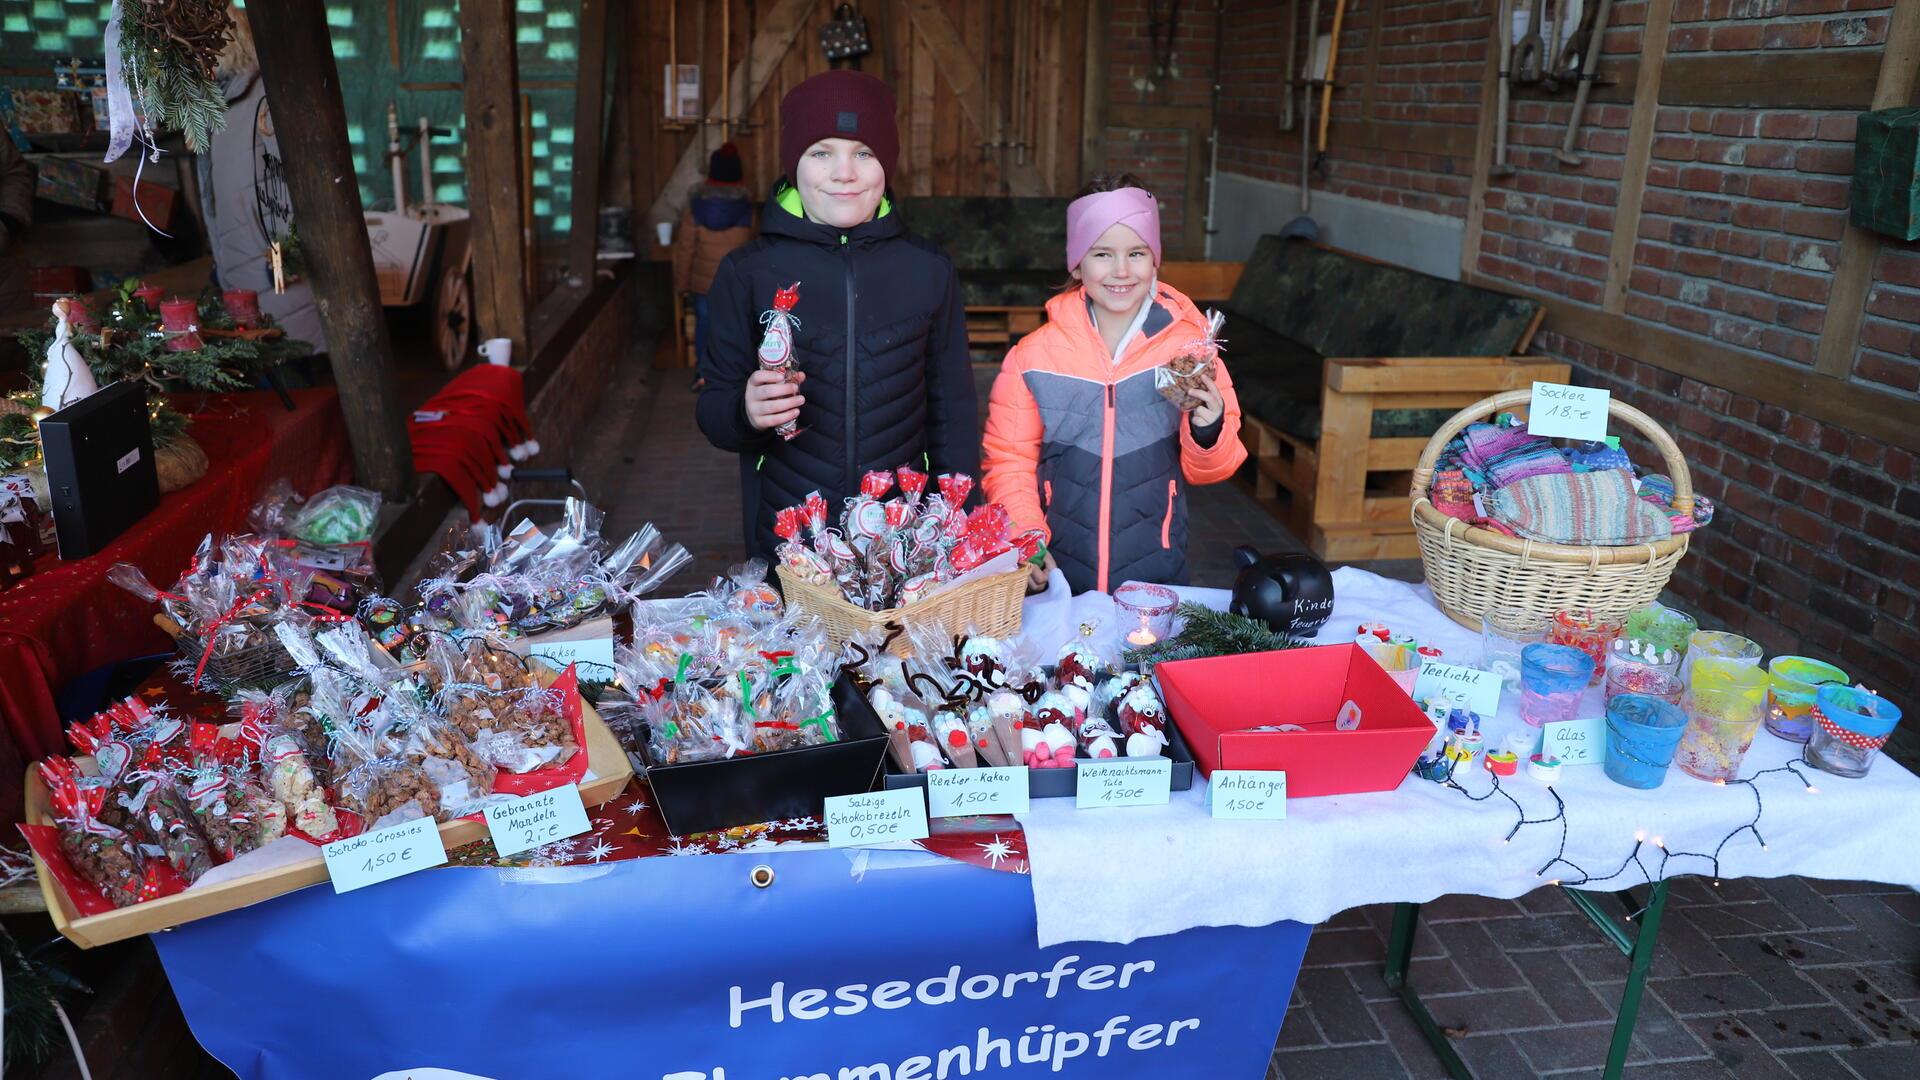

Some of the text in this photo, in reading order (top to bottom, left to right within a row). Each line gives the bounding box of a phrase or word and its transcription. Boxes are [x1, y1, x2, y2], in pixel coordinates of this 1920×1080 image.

[1540, 385, 1586, 401] Socken
[1294, 597, 1334, 615] Kinde
[1422, 662, 1480, 685] Teelicht
[1218, 774, 1285, 798] Anhänger
[492, 794, 554, 820] Gebrannte
[830, 806, 911, 825] Schokobrezeln
[508, 808, 557, 832] Mandeln
[729, 955, 1156, 1028] Hesedorfer
[662, 1015, 1201, 1080] menhüpfer
